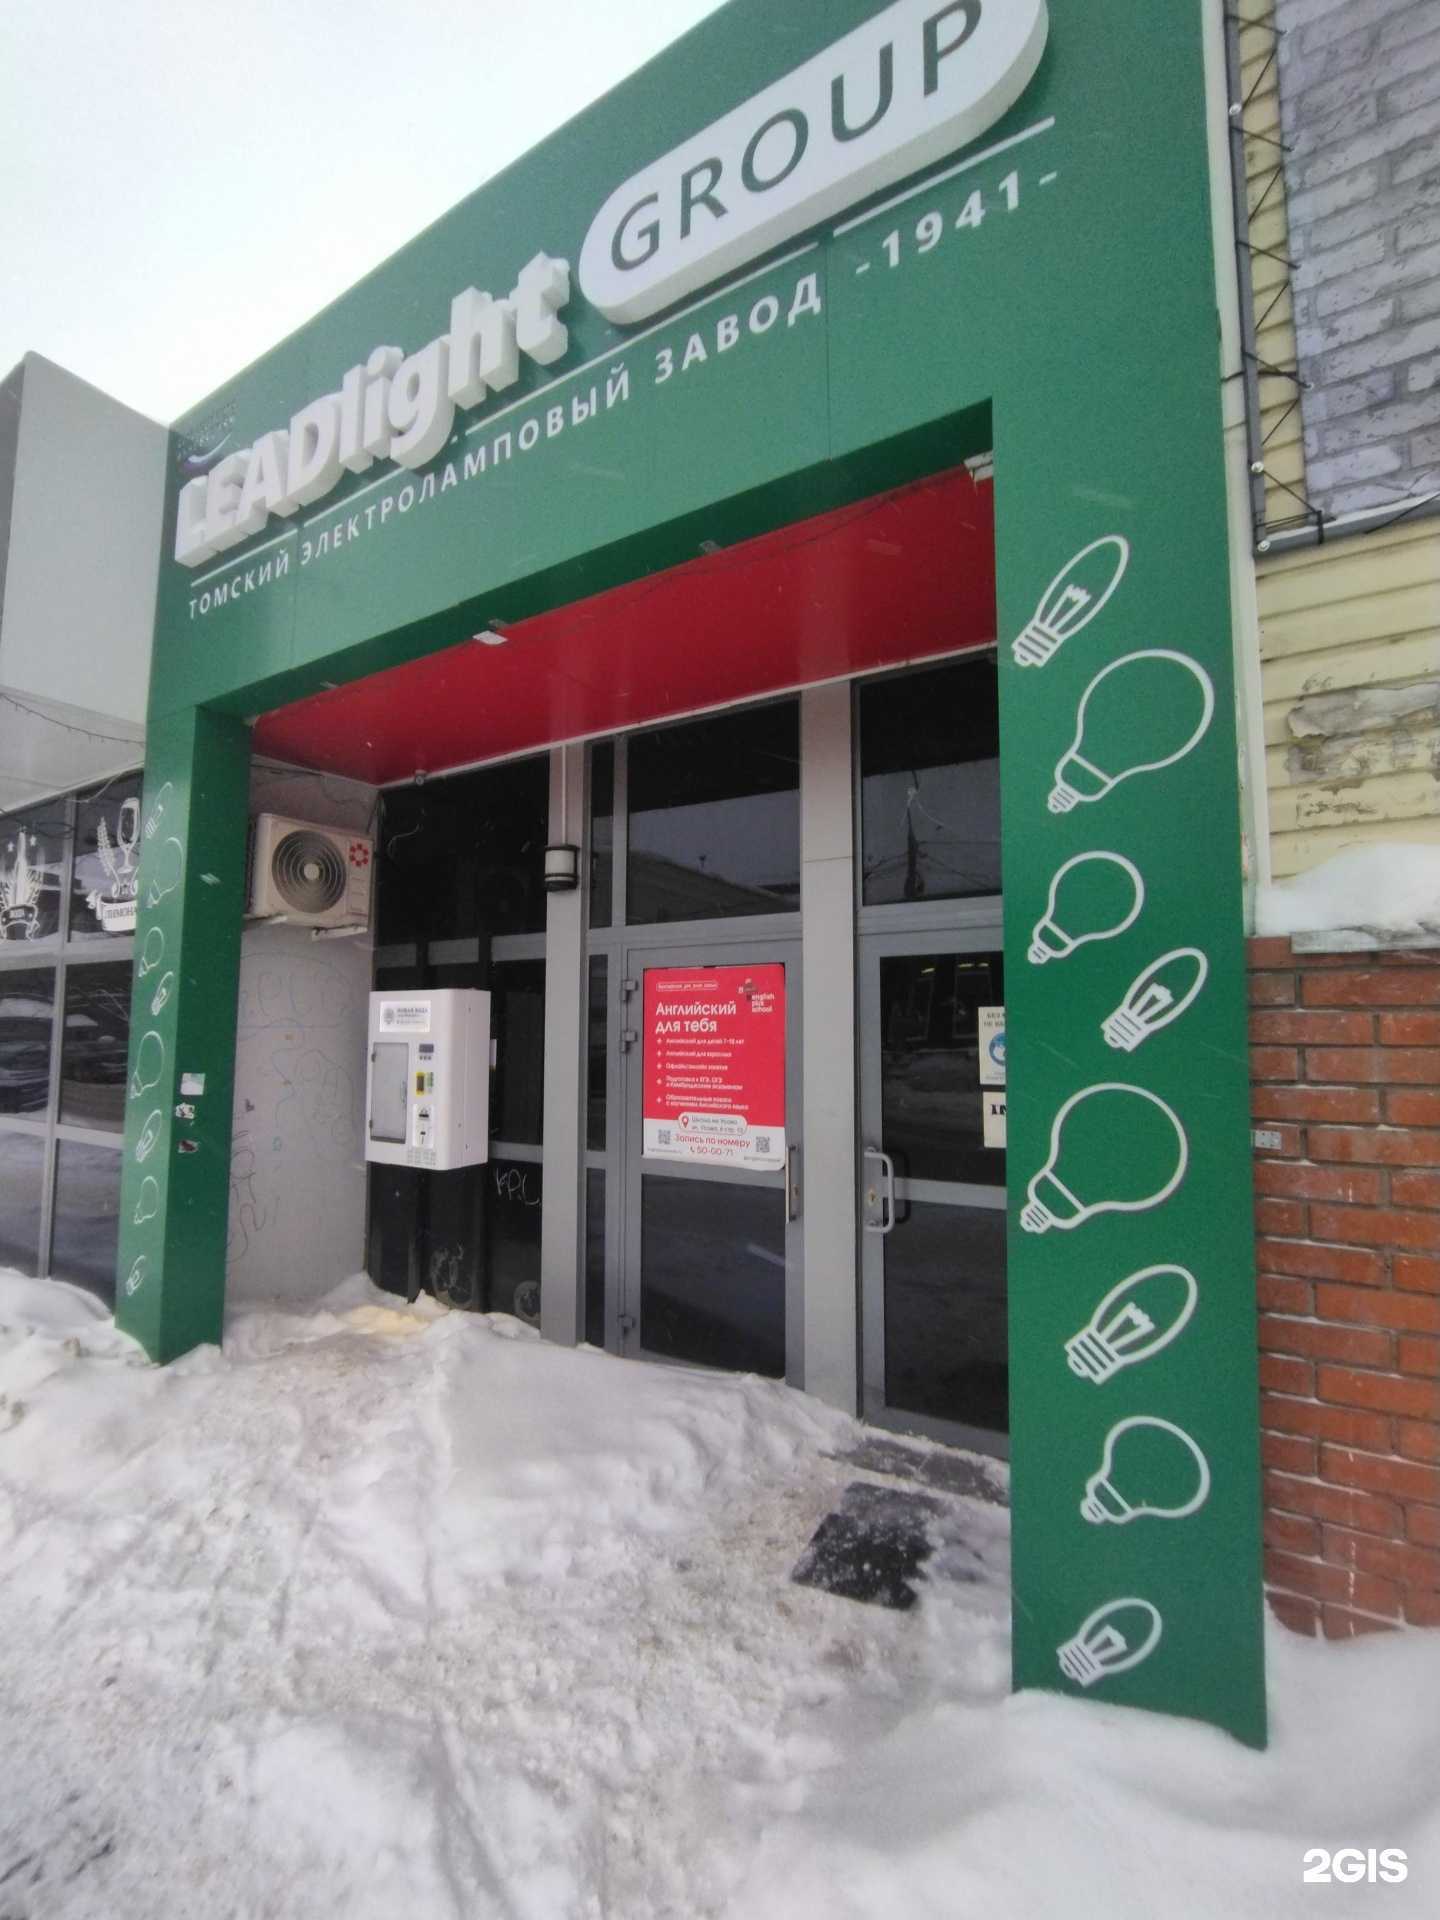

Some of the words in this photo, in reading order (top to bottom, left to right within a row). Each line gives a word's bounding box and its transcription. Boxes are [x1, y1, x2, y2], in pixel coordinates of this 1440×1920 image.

[175, 251, 569, 567] LEADlight
[611, 0, 982, 272] GROUP
[188, 547, 291, 619] ТОМСКИЙ
[300, 362, 631, 565] ЭЛЕКТРОЛАМПОВЫЙ
[655, 272, 822, 384] ЗАВОД
[656, 1000, 737, 1016] Английский
[655, 1020, 681, 1035] для
[674, 1133, 704, 1144] Запись
